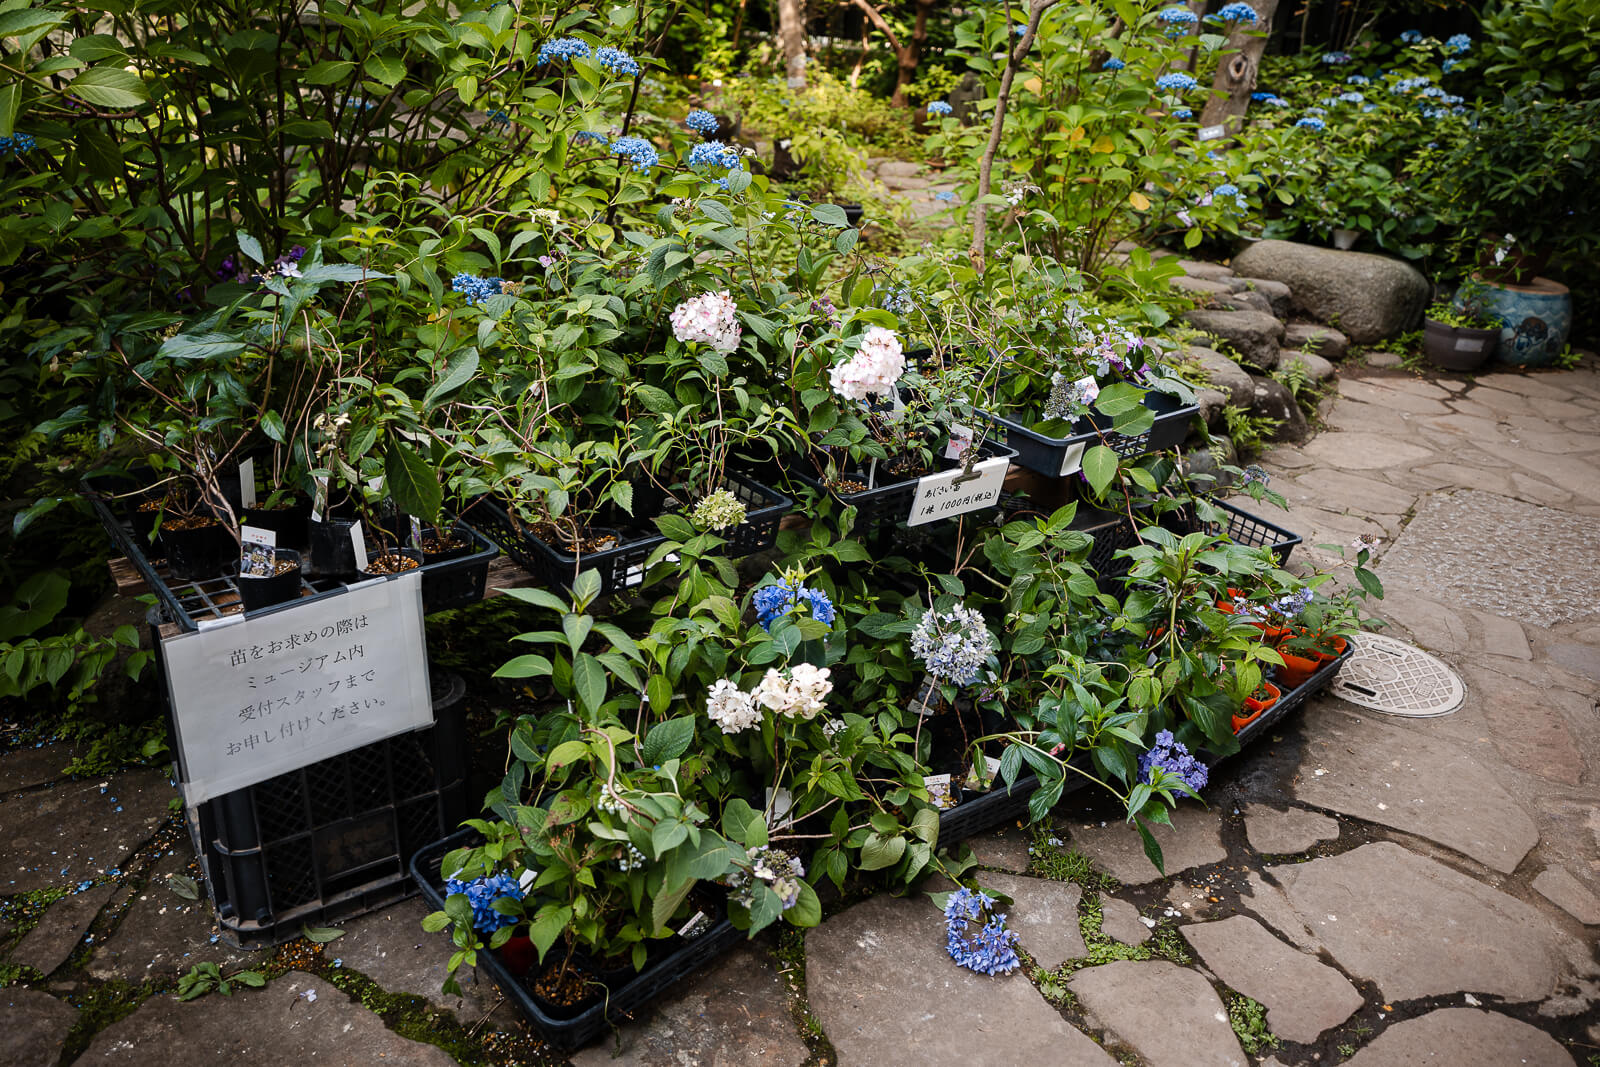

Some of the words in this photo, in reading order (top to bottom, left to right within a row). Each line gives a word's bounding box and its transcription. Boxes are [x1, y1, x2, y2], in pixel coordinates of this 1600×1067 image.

[230, 615, 369, 667] 苗をお求めの際は
[248, 644, 364, 688] ミュージアム内
[239, 669, 376, 723] 受付スタッフまで
[227, 698, 386, 755] お申し付けください。
